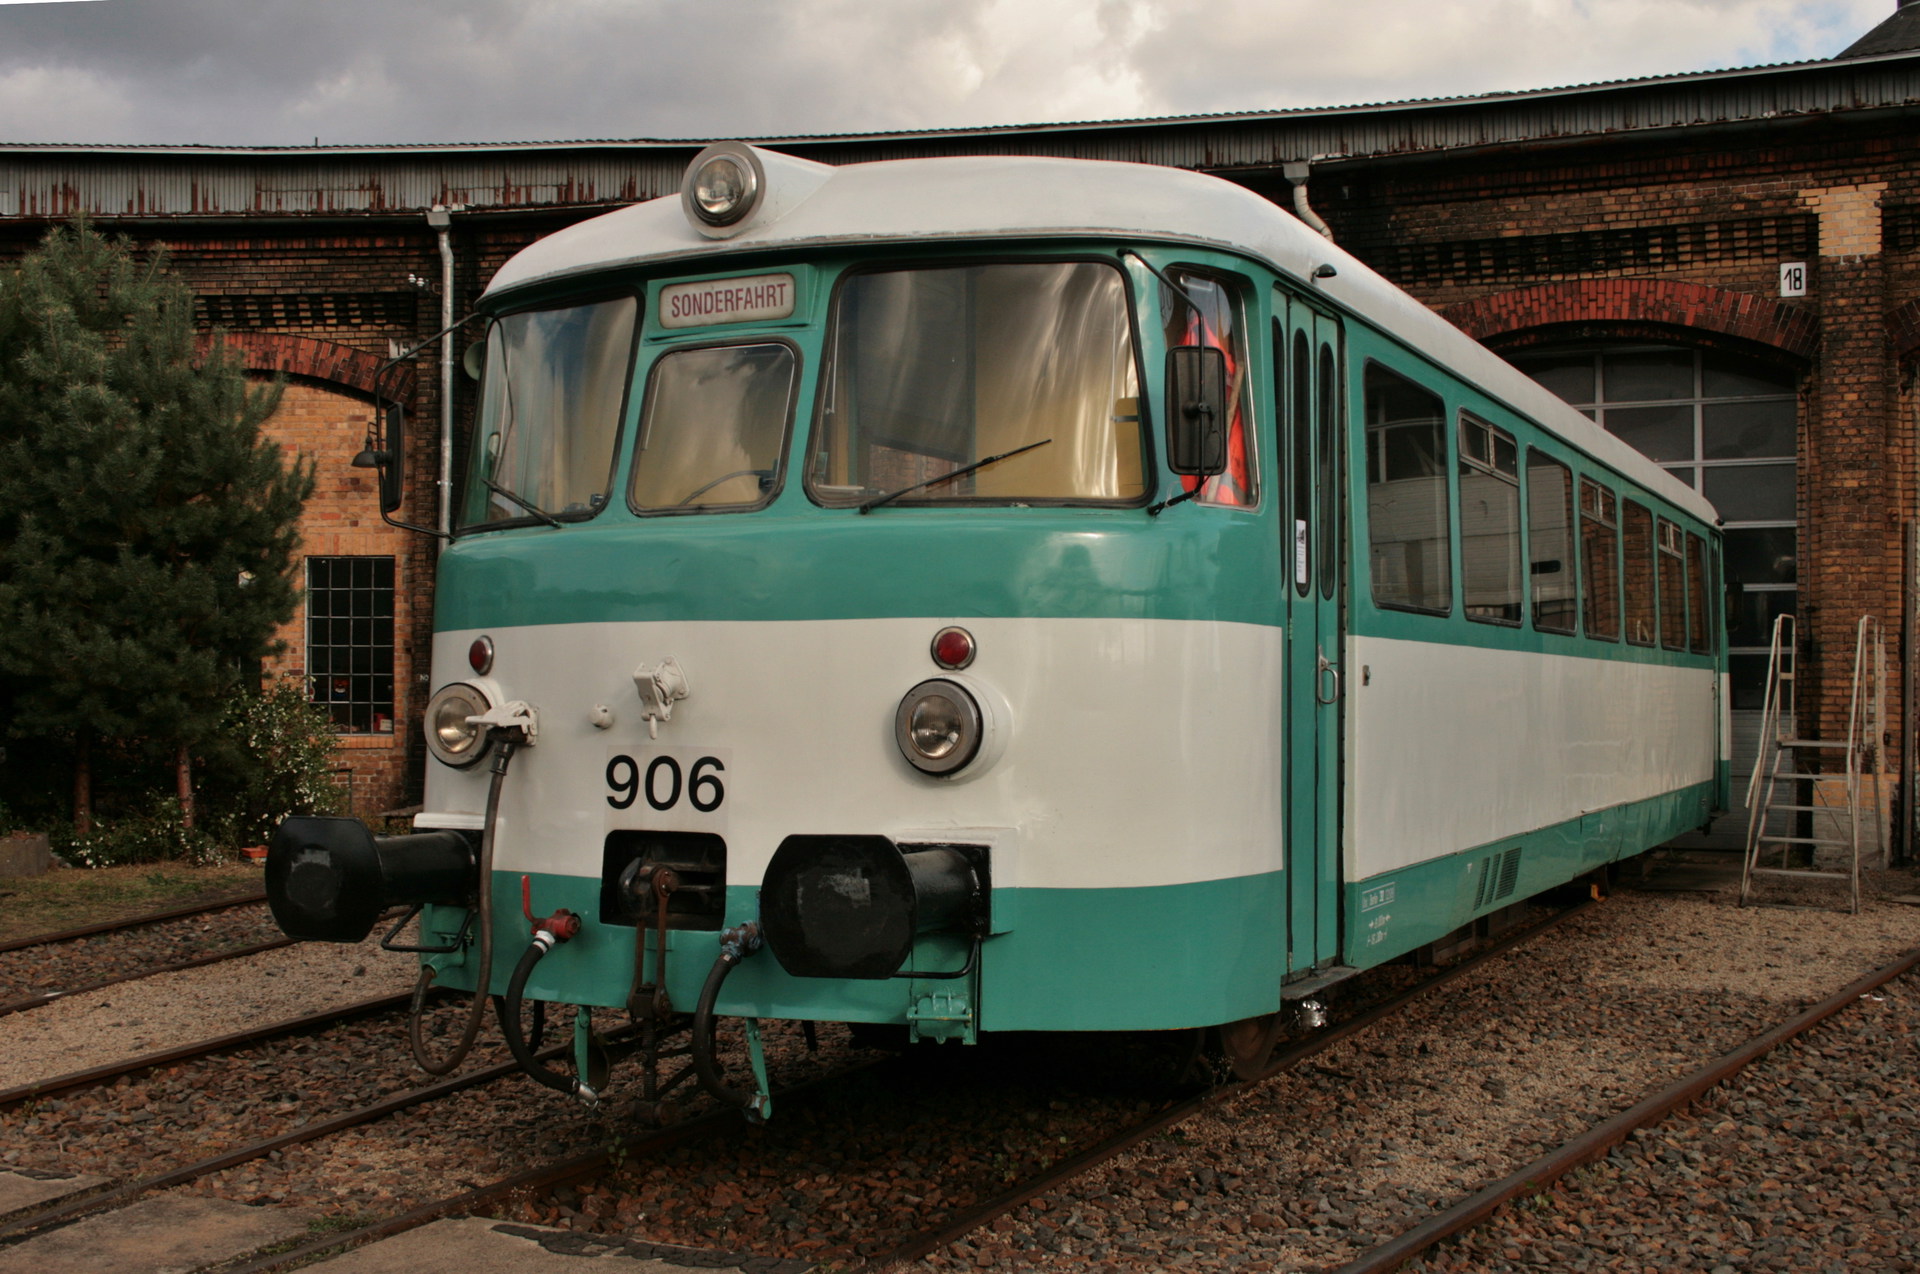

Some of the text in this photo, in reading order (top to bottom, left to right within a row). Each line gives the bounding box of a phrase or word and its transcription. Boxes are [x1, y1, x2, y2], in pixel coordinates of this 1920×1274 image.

[1783, 267, 1803, 291] 18
[671, 283, 787, 319] SONDERFAHRT
[605, 754, 726, 813] 906
